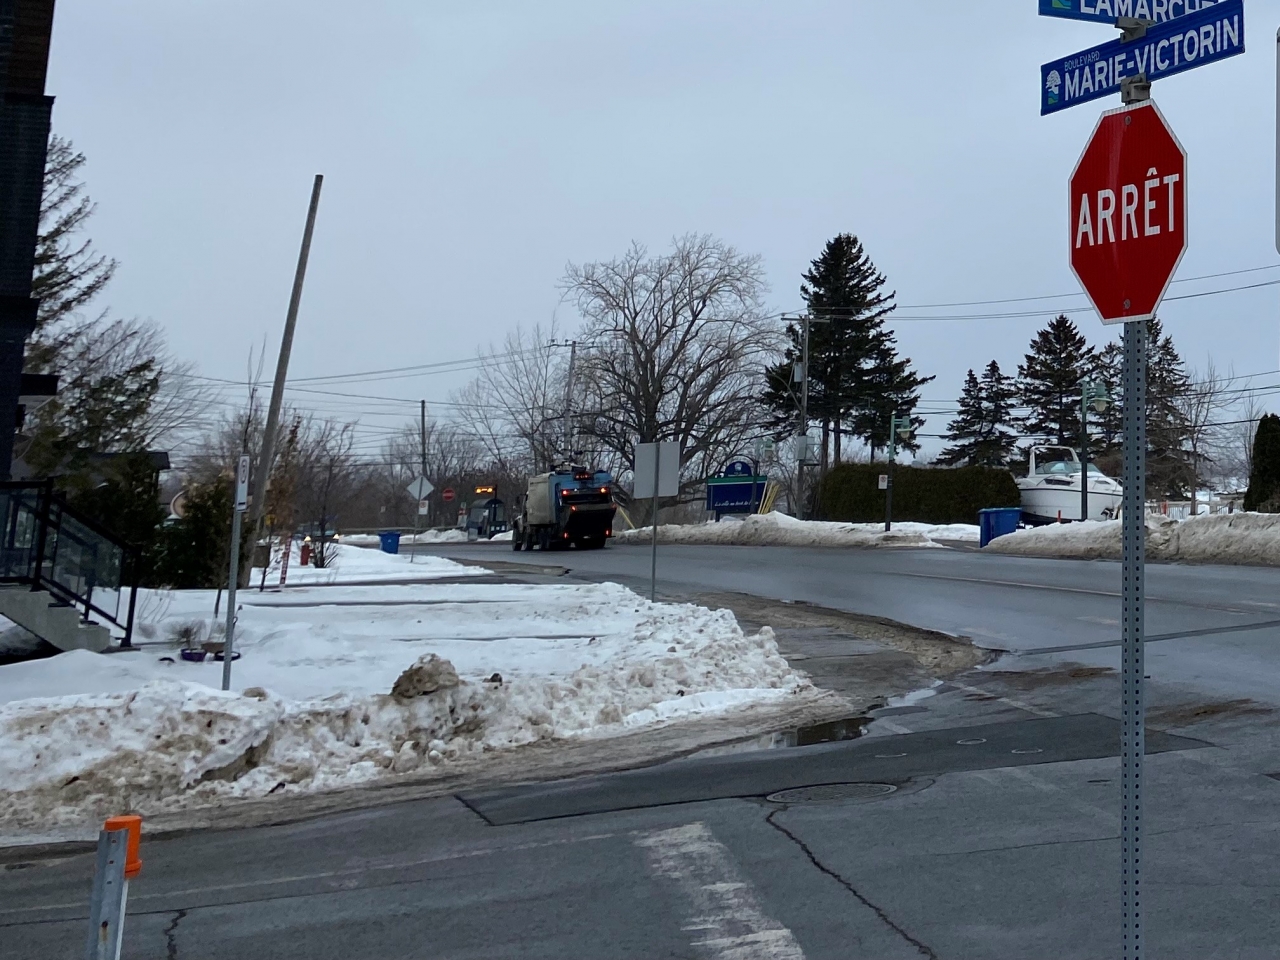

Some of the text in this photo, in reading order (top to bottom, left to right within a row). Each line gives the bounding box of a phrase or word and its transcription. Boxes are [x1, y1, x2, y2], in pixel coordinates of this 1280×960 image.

[1064, 15, 1239, 101] MARIE-VICTORIN
[1064, 51, 1100, 71] BOULEVARD
[1075, 167, 1180, 249] ARRÊT
